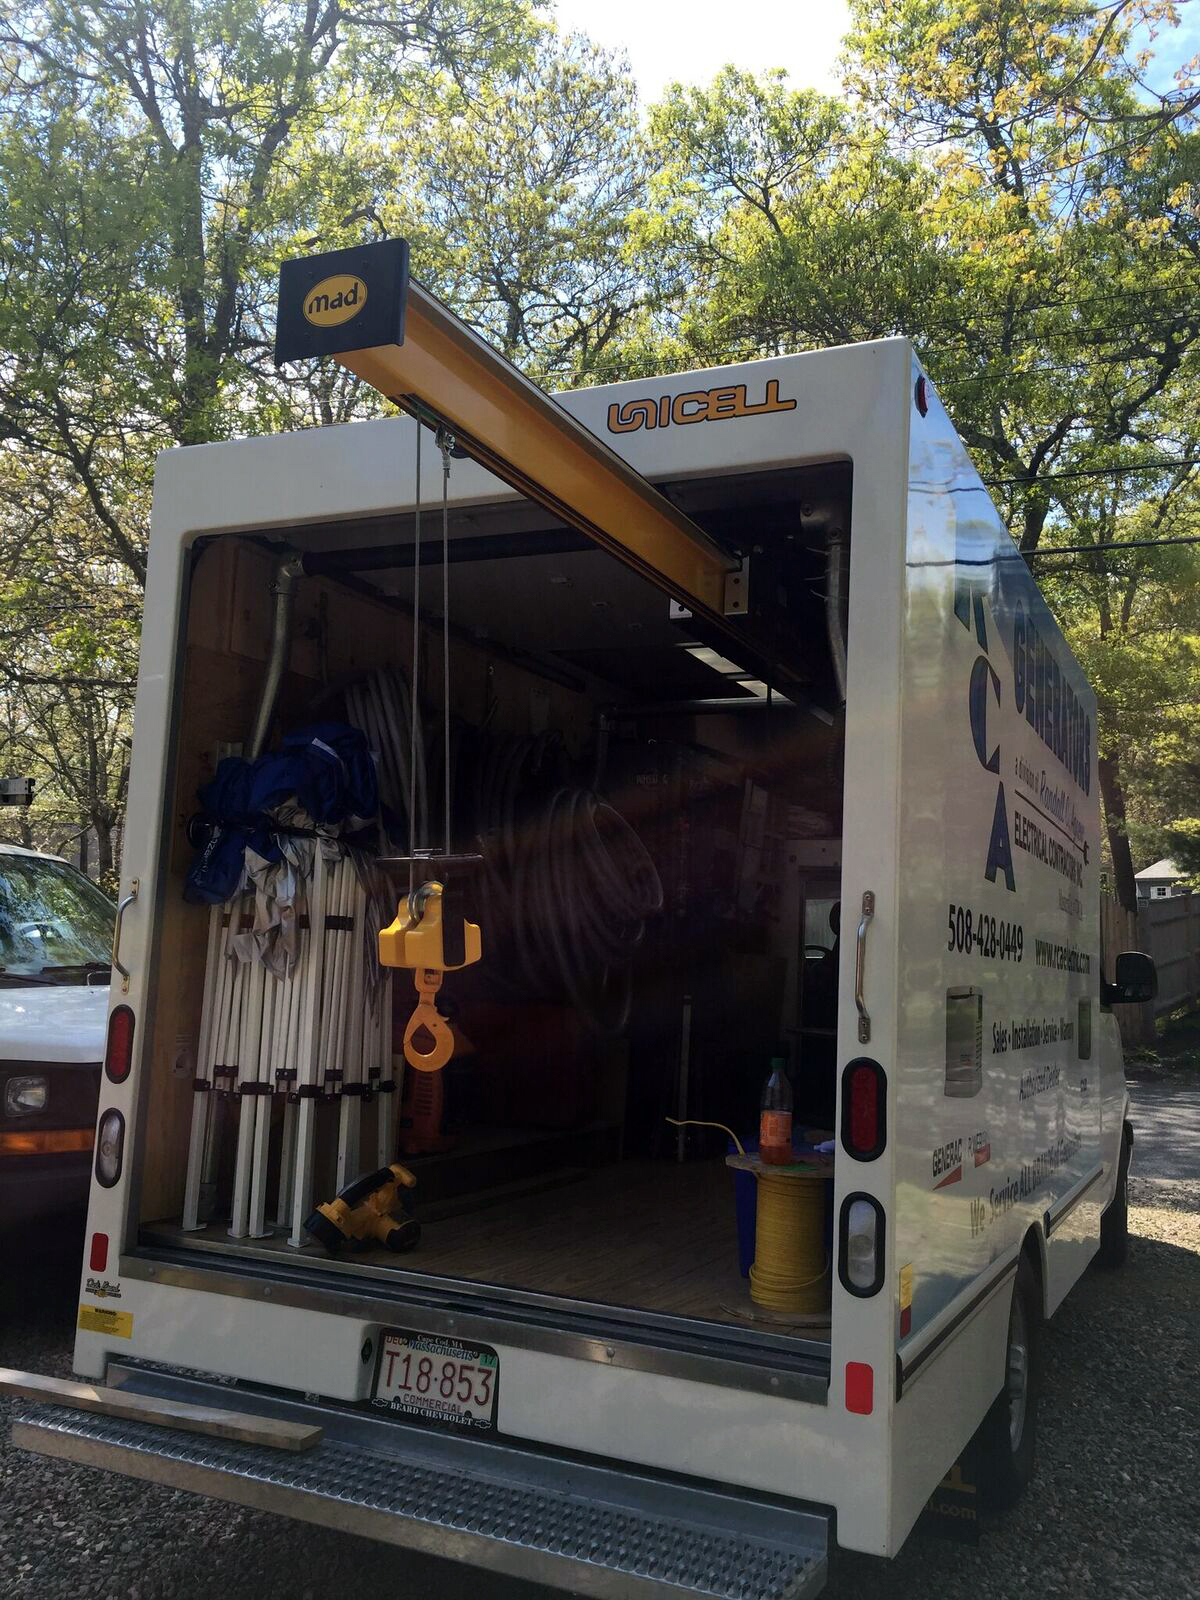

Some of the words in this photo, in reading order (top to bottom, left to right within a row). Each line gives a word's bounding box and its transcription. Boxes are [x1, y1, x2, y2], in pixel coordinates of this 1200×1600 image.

[308, 282, 359, 314] mad
[607, 379, 798, 435] UNICELL
[1014, 810, 1049, 865] ELECTRICAL
[948, 904, 1023, 963] 508-428-0449
[992, 1021, 1008, 1055] Sales
[932, 1138, 962, 1178] GENERAC
[970, 1196, 985, 1239] We
[989, 1176, 1019, 1225] Service
[407, 1340, 474, 1361] Massachusetts
[390, 1402, 419, 1416] BEARD
[420, 1407, 474, 1426] CHEVROLET
[403, 1393, 463, 1415] COMMERCIAL
